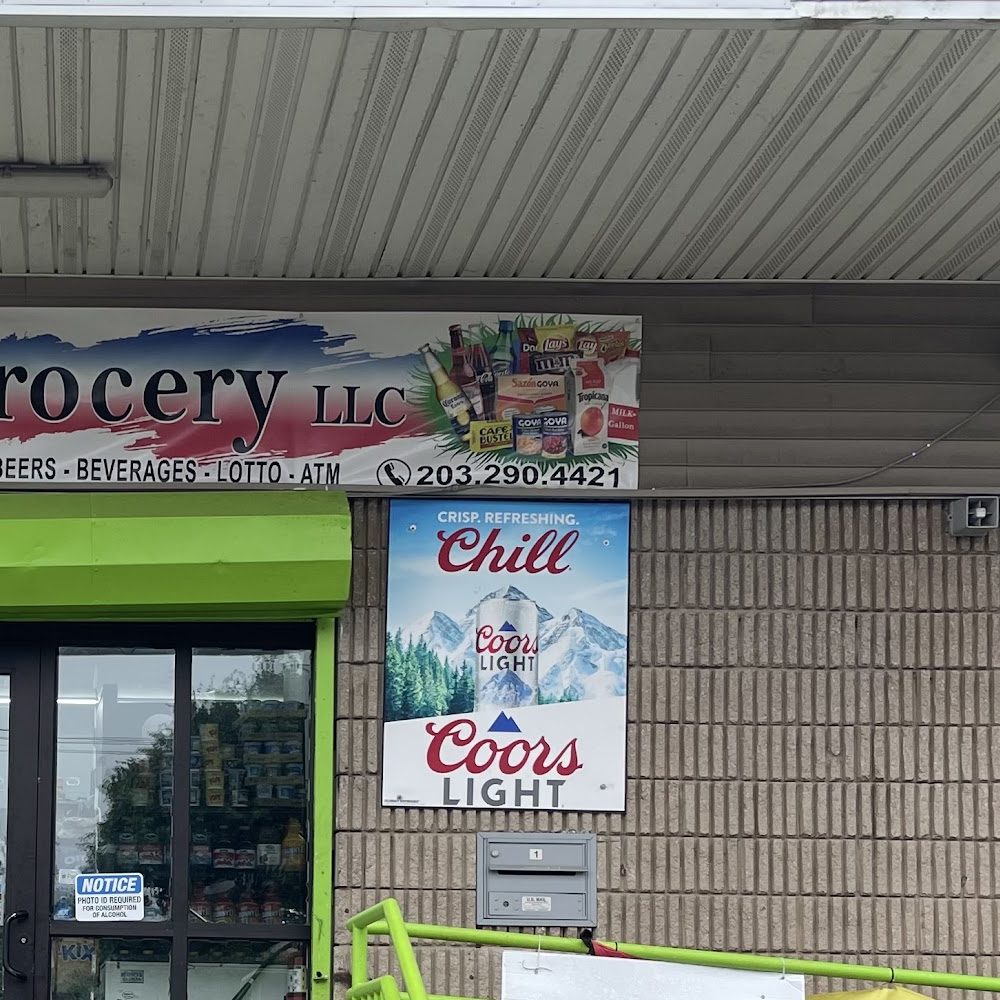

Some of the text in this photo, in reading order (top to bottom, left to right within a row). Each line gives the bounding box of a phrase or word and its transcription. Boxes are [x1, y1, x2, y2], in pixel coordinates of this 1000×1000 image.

[536, 380, 559, 388] GOYA
[577, 391, 609, 403] Tropicana
[310, 384, 407, 428] LLC
[608, 420, 635, 430] Gallon
[480, 432, 513, 444] BUSTEL
[77, 458, 197, 483] BEVERAGES
[217, 460, 282, 485] LOTTO
[301, 462, 340, 486] ATM
[416, 464, 620, 488] 203.290.4421
[437, 511, 580, 526] CRISP. REFRESHING.
[436, 526, 580, 575] Chill
[475, 624, 538, 655] Coors
[480, 655, 535, 673] LIGHT
[425, 718, 583, 777] Coors
[442, 777, 567, 808] LIGHT
[533, 850, 540, 859] 1
[81, 877, 138, 893] NOTICE
[77, 896, 142, 905] PHOTO ID REQUIRED
[95, 904, 137, 912] CONSUMPTION
[60, 943, 95, 961] KIX
